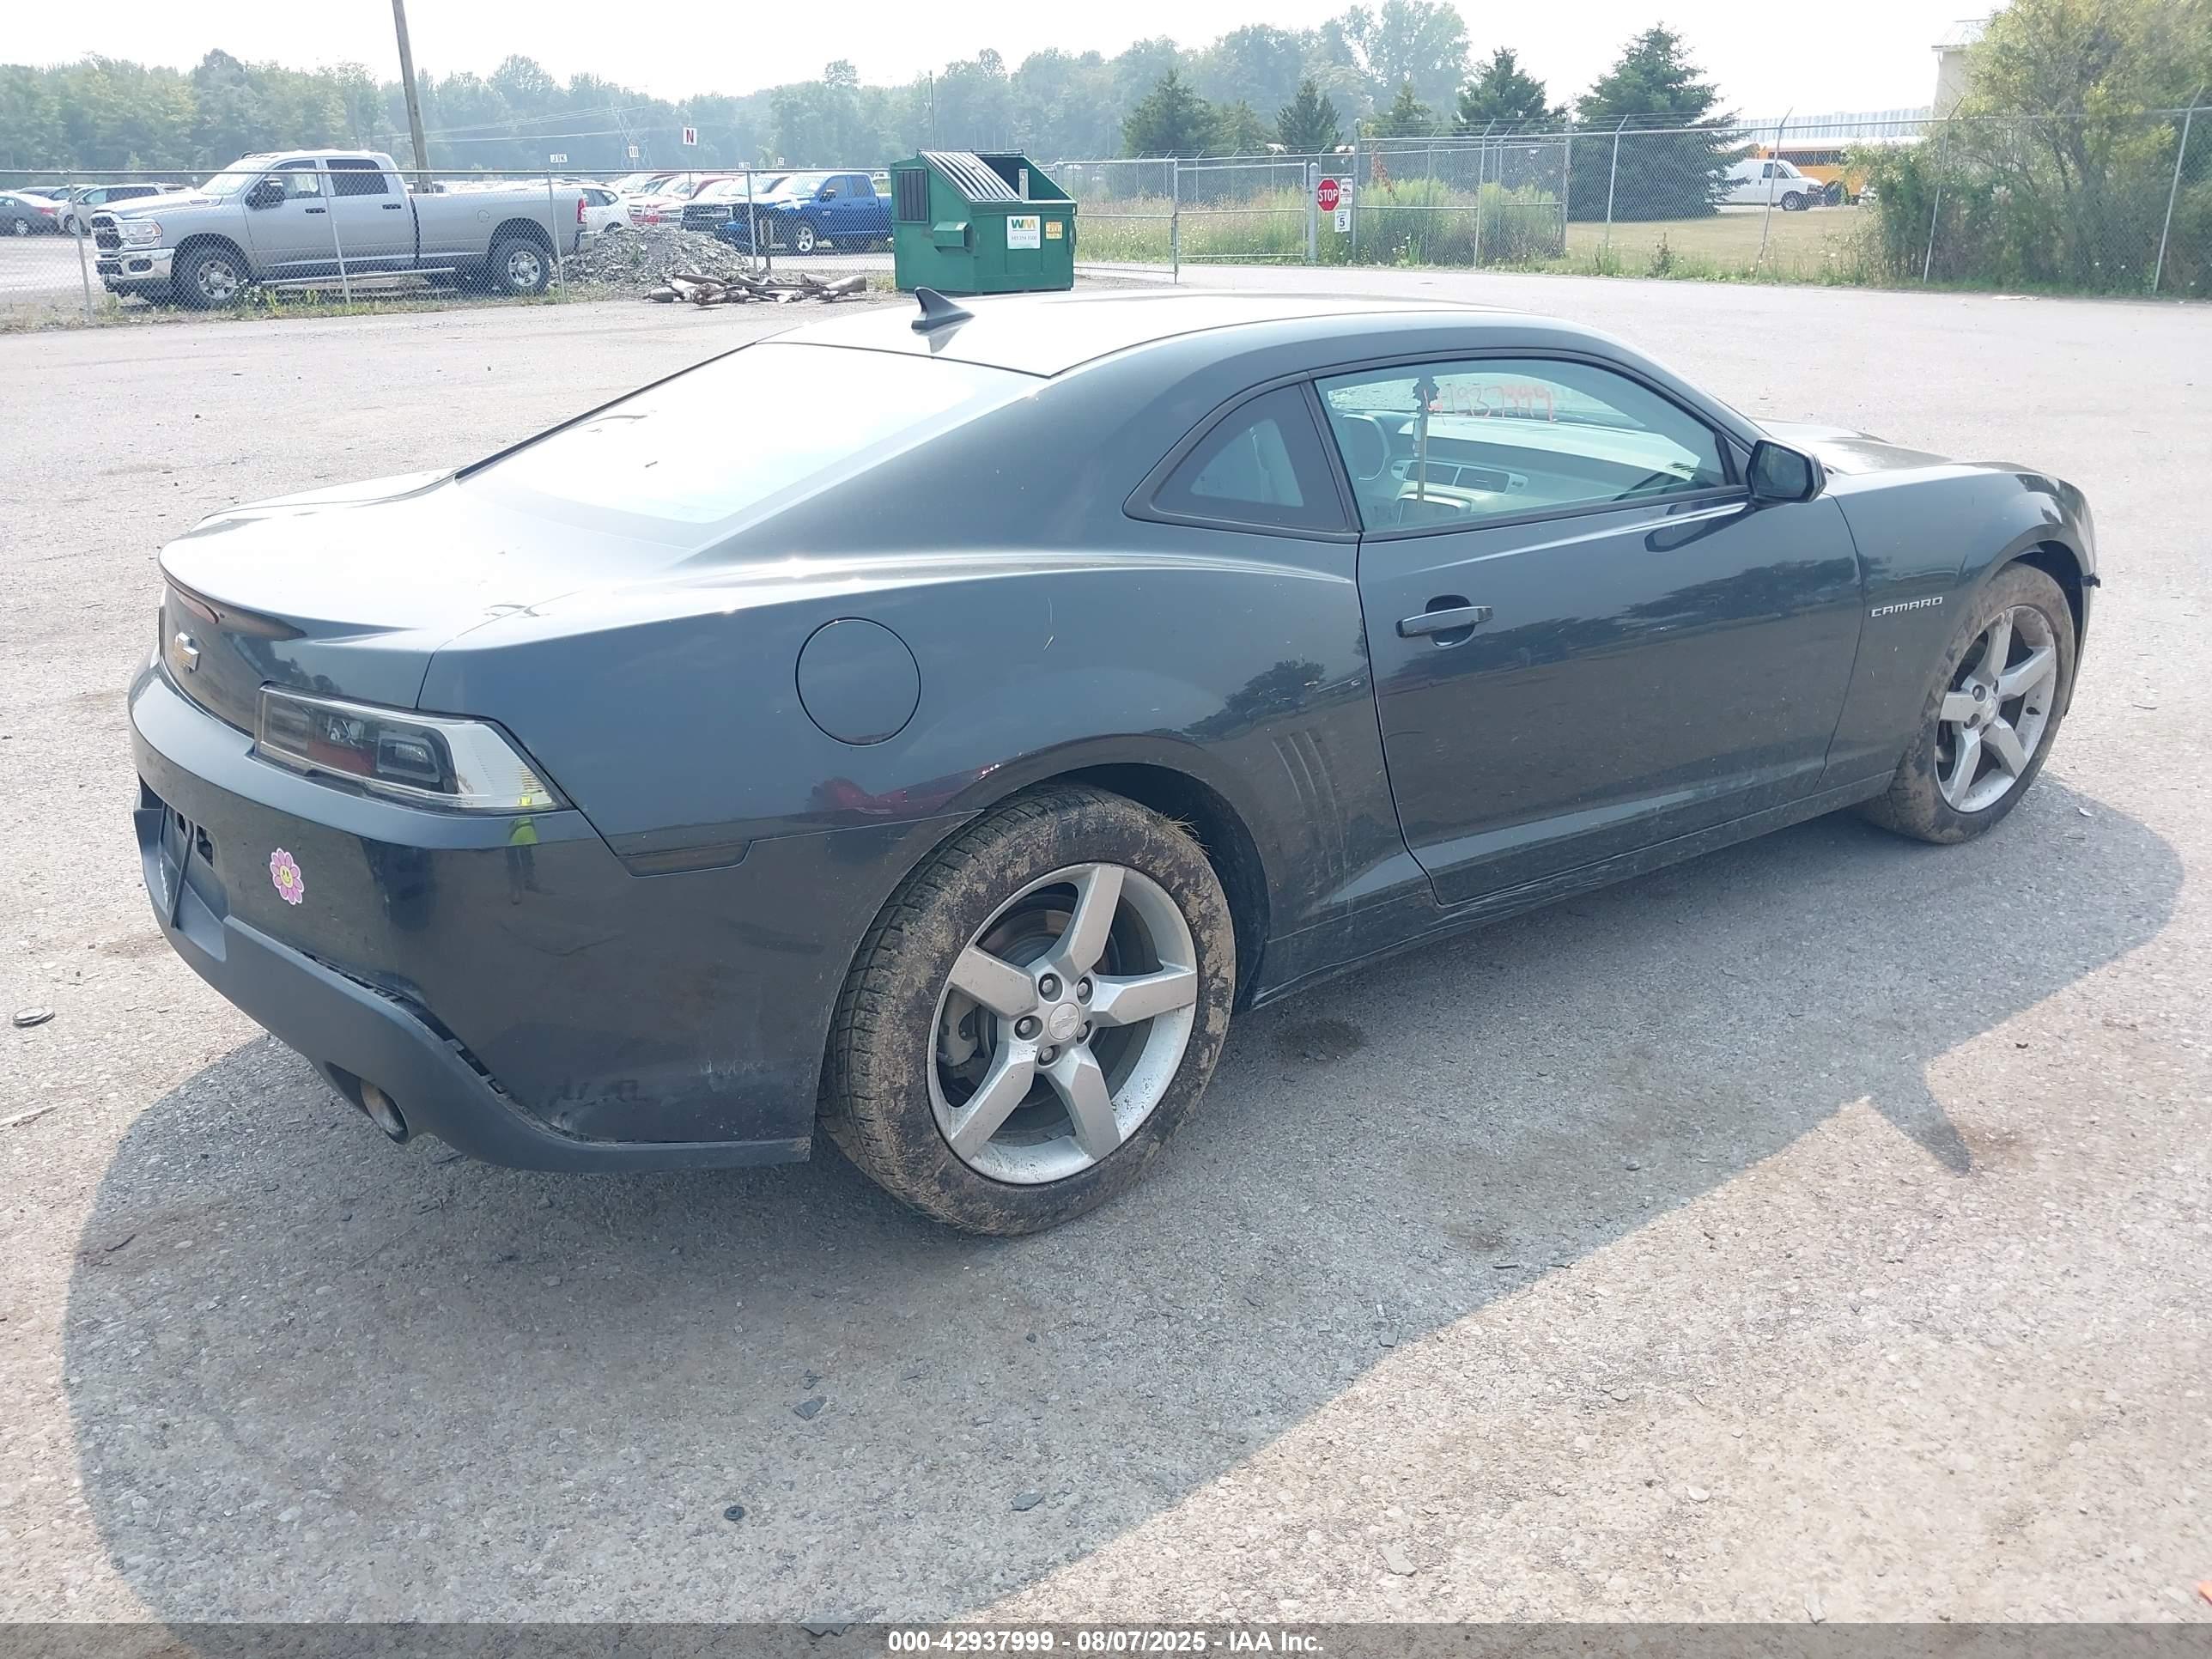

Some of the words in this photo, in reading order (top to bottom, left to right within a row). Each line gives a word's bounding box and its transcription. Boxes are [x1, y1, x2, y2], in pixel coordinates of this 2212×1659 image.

[686, 129, 694, 143] N
[1318, 188, 1338, 203] STOP
[1011, 219, 1036, 228] WM
[1340, 217, 1346, 227] 5
[1870, 596, 1944, 617] CAMARO
